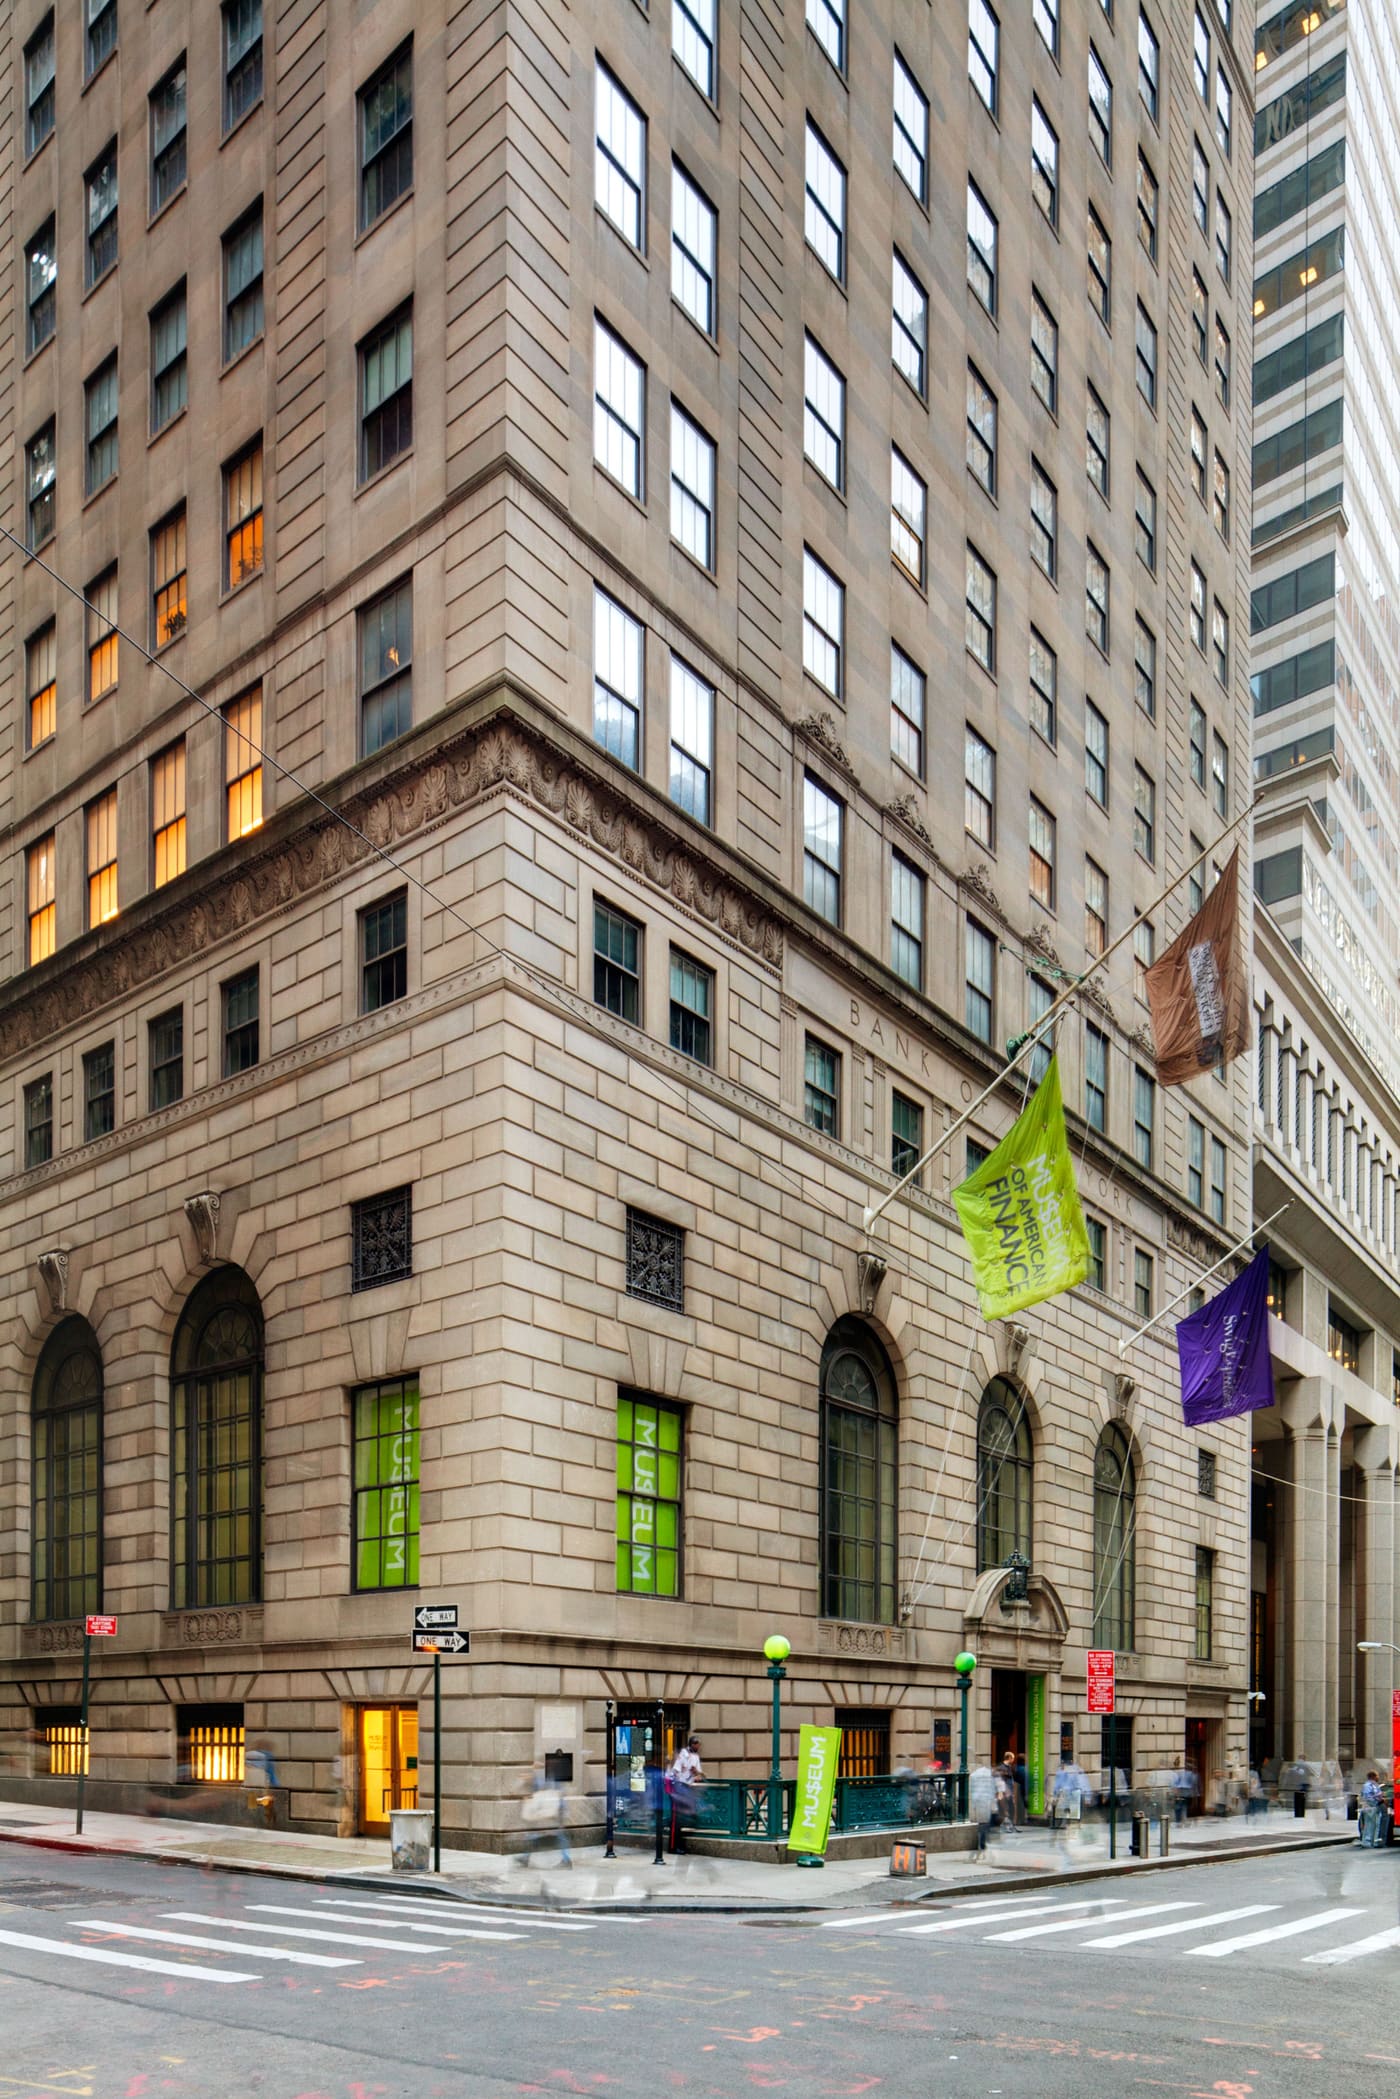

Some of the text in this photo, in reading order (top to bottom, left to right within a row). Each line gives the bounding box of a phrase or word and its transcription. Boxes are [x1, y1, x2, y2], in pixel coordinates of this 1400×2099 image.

[850, 1000, 930, 1077] BANK
[1084, 1165, 1133, 1216] YORK
[985, 1176, 1030, 1297] FINANCE
[1011, 1167, 1048, 1288] OF AMERICAN
[421, 1612, 453, 1622] ONE WAY
[421, 1637, 461, 1647] ONE WAY
